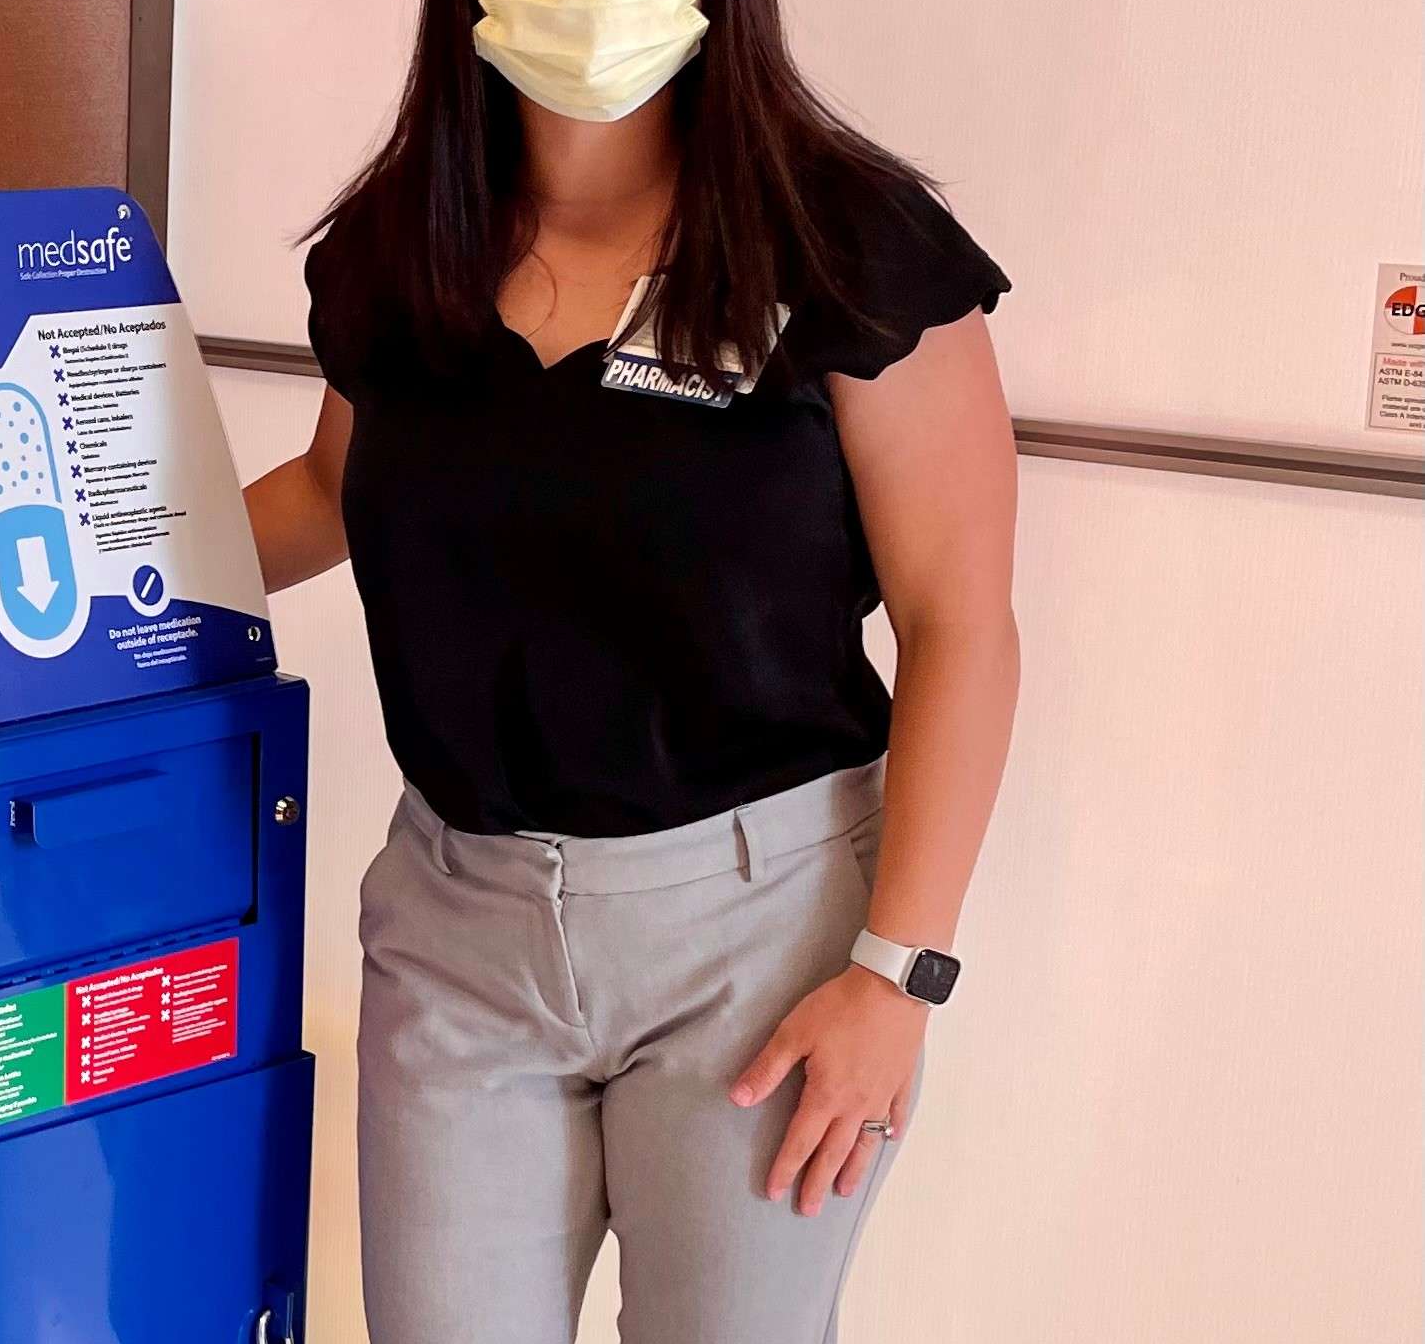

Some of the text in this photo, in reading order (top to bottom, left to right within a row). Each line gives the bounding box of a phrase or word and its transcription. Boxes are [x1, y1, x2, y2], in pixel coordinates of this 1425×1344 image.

[17, 226, 132, 272] medsafe
[38, 329, 55, 342] Not
[119, 319, 166, 335] Aceptados
[109, 615, 202, 641] Do not leave medication
[116, 637, 147, 651] outside
[148, 635, 156, 647] of
